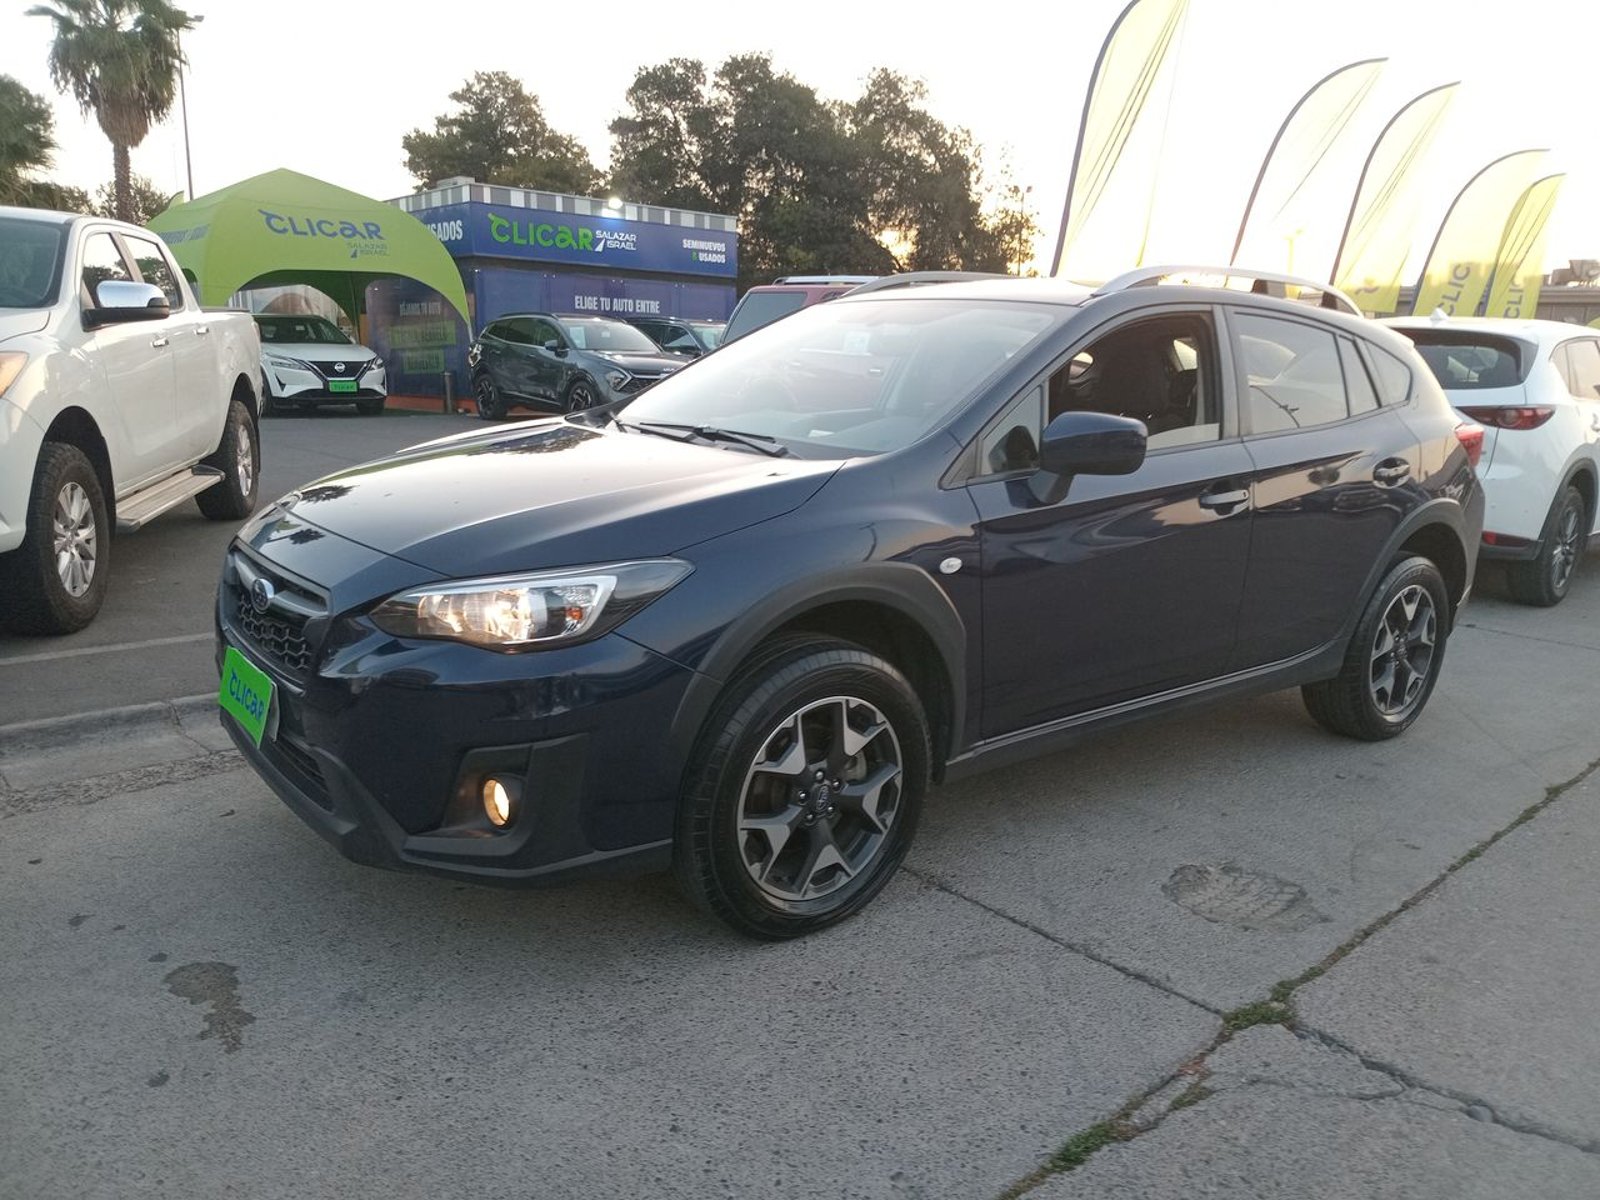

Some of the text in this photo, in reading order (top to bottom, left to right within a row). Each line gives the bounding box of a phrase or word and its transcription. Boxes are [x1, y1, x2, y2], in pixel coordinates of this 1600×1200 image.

[595, 230, 637, 242] SALAZAR
[606, 240, 637, 251] ISRAEL
[682, 238, 726, 253] SEMINUEVOS
[698, 252, 726, 264] USADOS
[574, 295, 661, 314] ELIGE TU AUTO ENTRE
